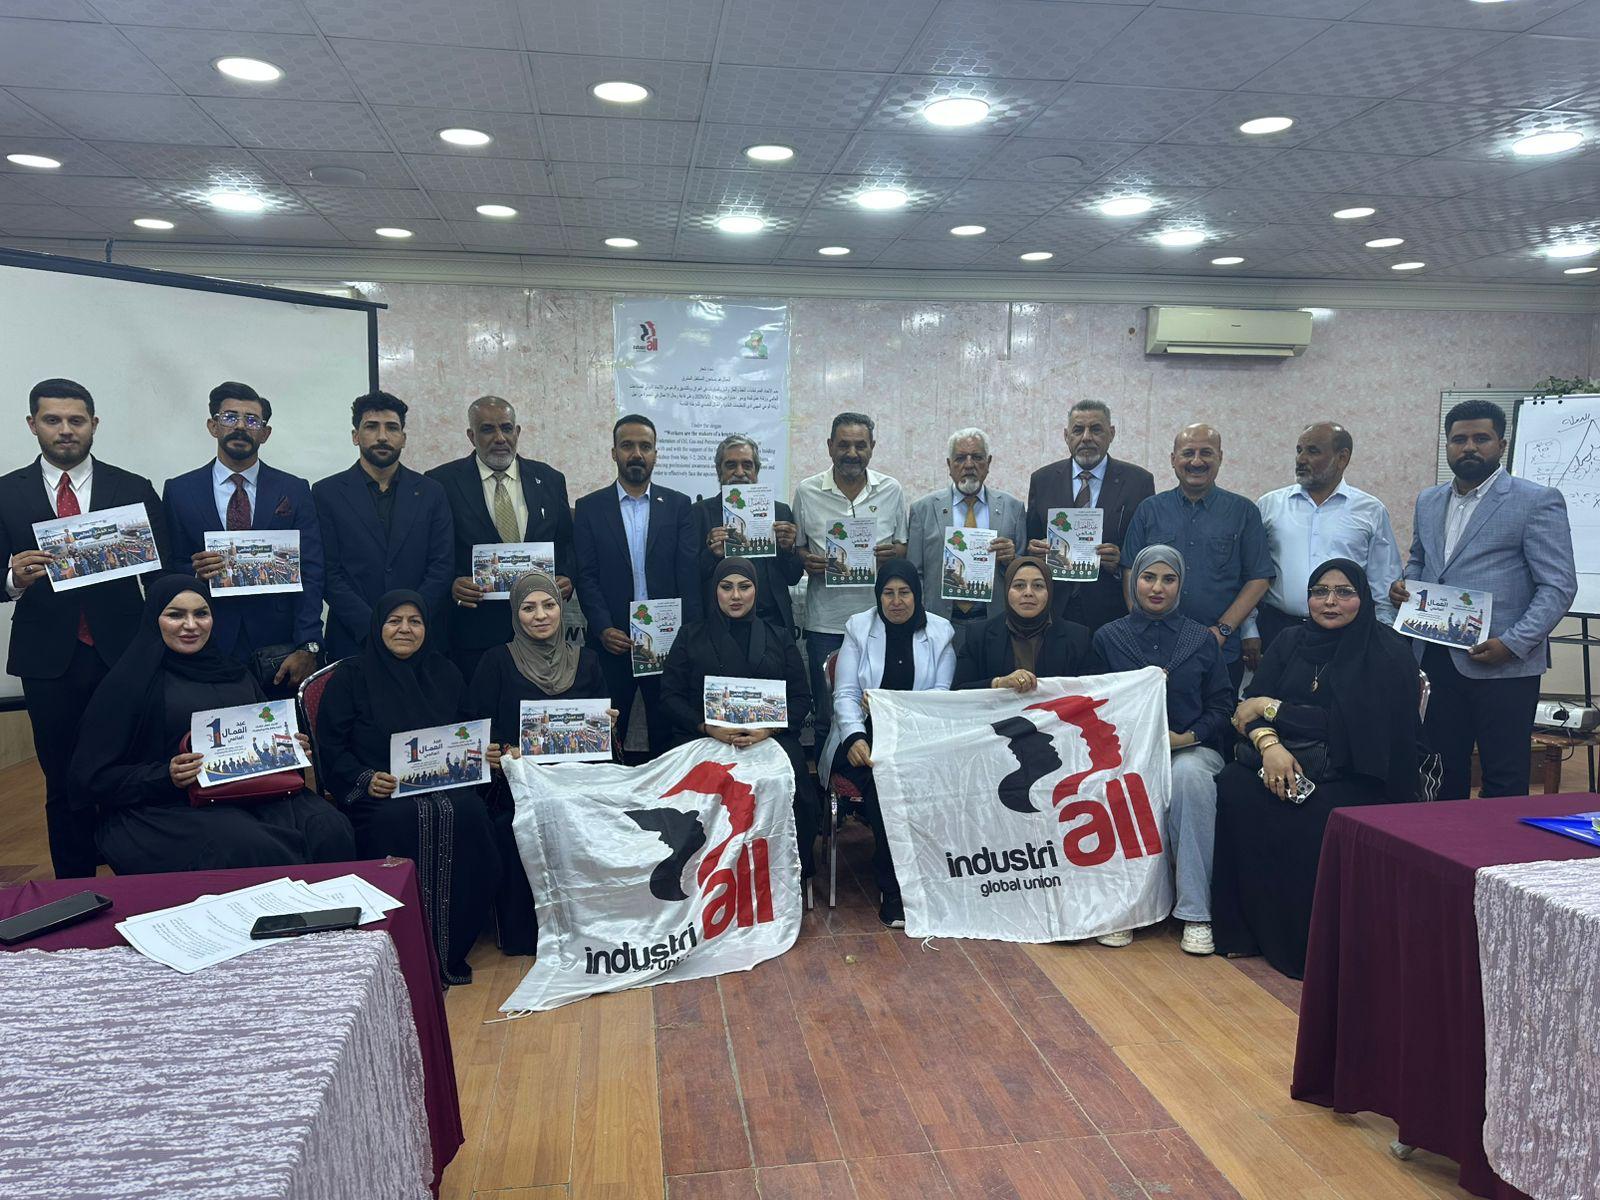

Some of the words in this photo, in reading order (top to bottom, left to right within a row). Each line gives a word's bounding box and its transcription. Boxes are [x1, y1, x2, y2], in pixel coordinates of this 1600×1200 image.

[647, 337, 658, 352] all
[1427, 599, 1449, 608] العمال
[206, 717, 226, 749] 1
[222, 726, 247, 738] العمال
[227, 734, 244, 743] العالمي
[405, 736, 421, 764] 1
[419, 743, 443, 754] العمال
[945, 840, 1058, 877] industri
[1058, 771, 1164, 867] all
[980, 877, 1021, 897] global
[1023, 875, 1061, 889] union
[585, 922, 697, 974] industri
[702, 837, 774, 940] all
